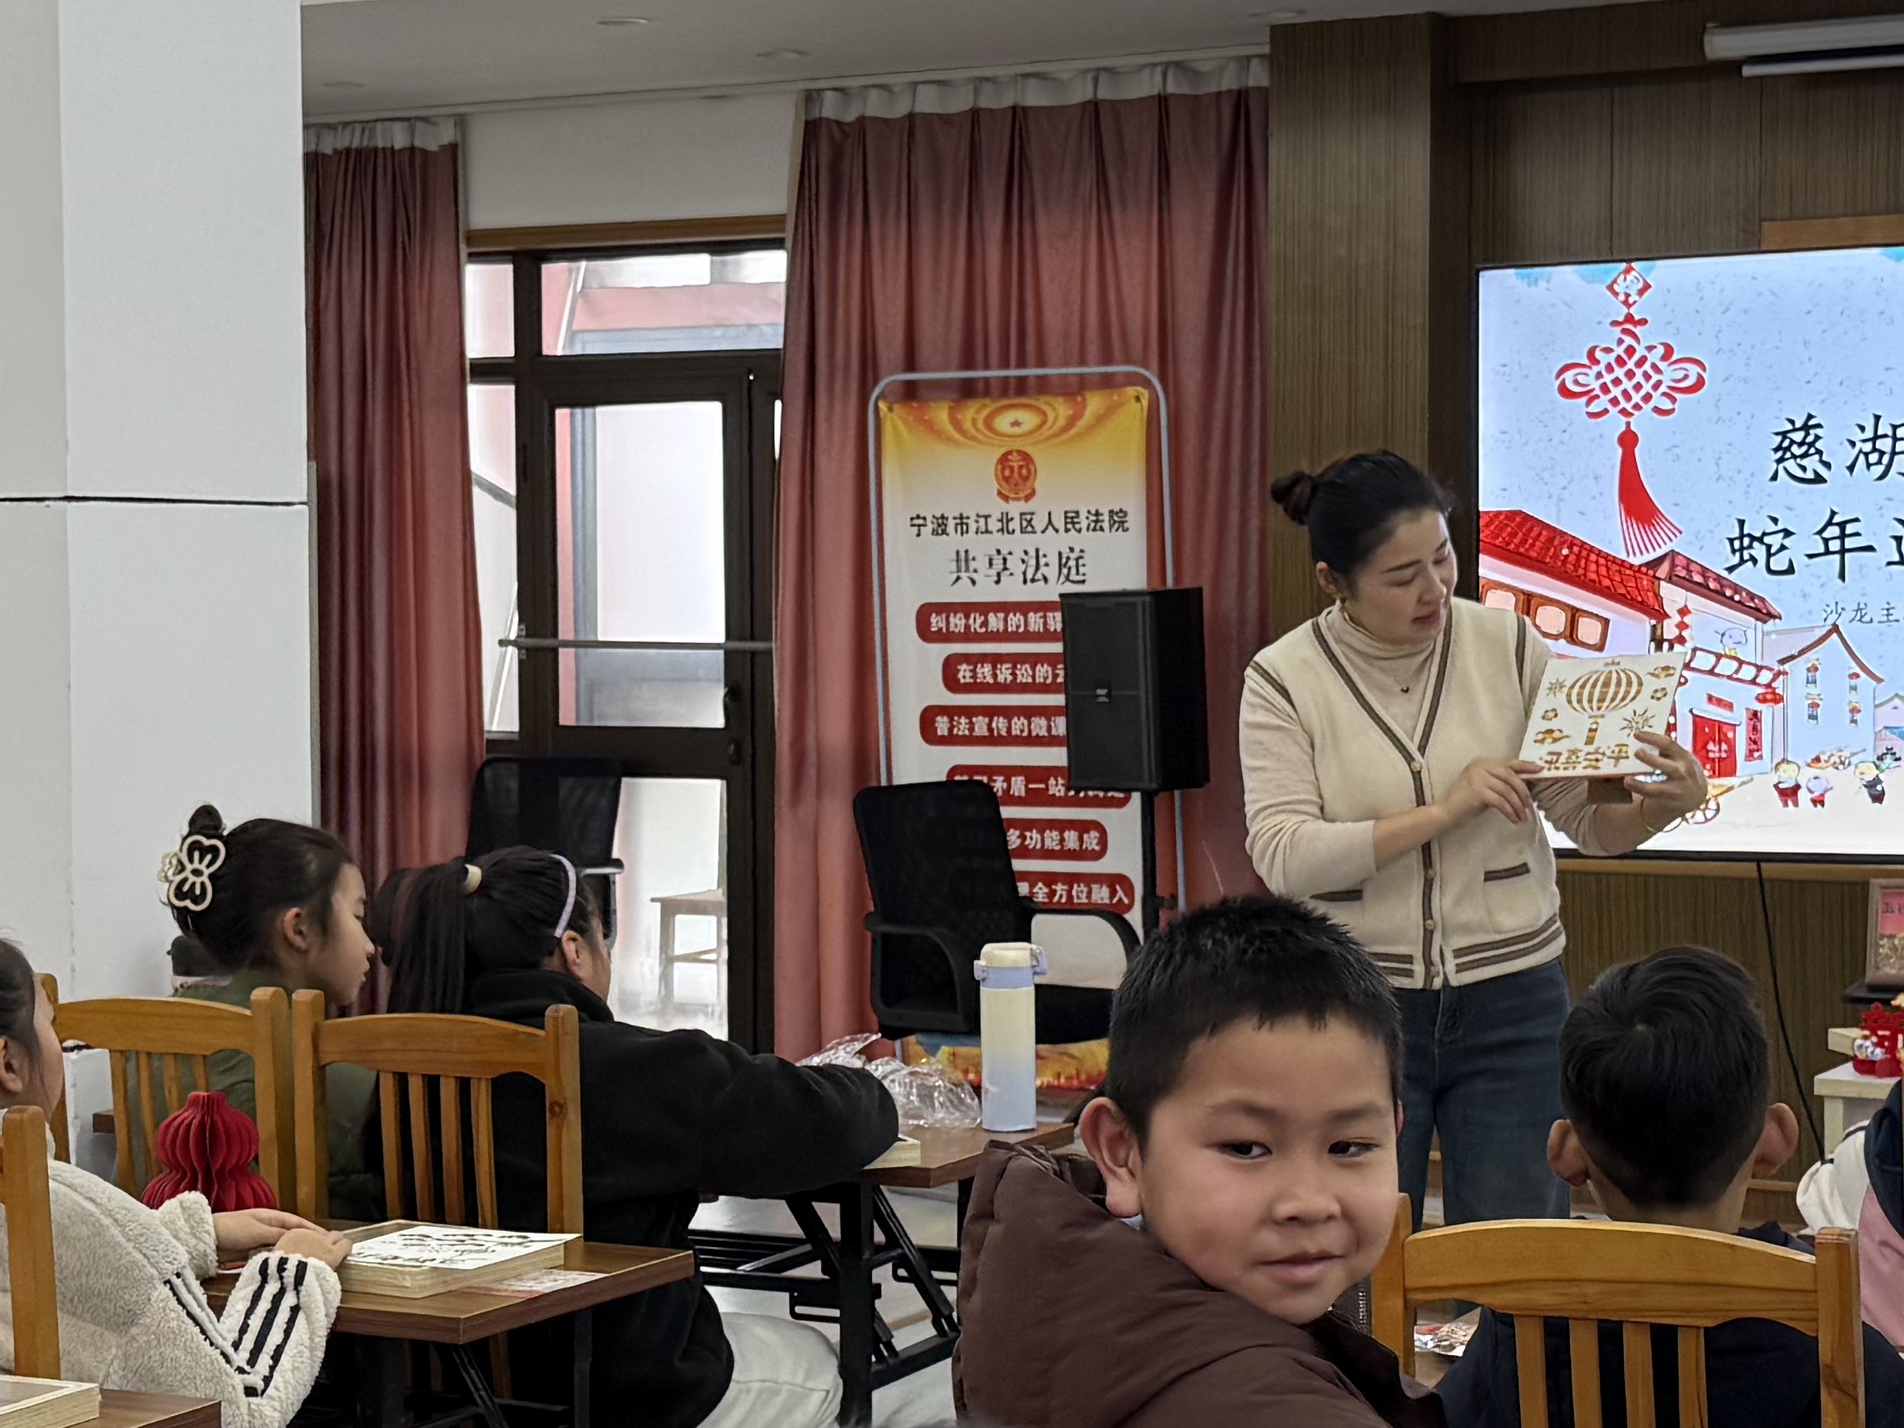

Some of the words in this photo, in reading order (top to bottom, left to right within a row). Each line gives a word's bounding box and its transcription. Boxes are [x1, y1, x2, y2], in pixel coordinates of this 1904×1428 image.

[909, 508, 1130, 538] 宁波市江北区人民法院
[949, 546, 1087, 587] 共享法庭
